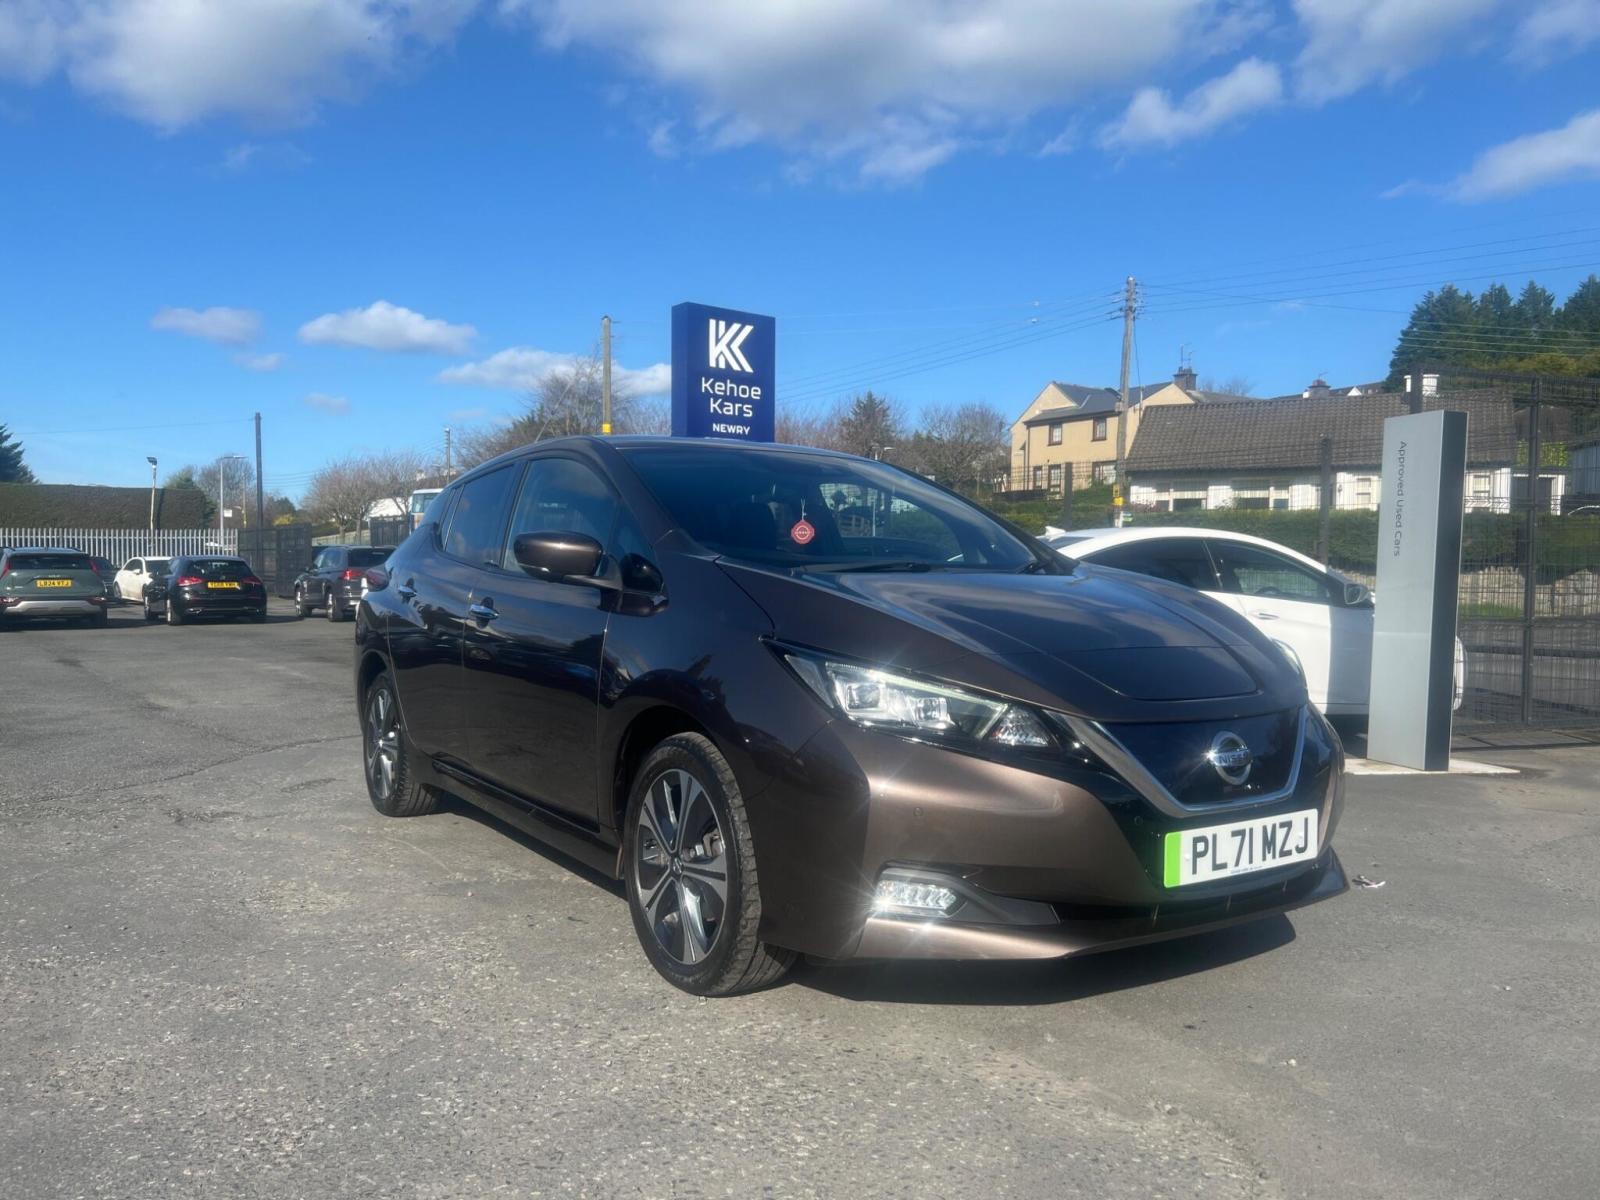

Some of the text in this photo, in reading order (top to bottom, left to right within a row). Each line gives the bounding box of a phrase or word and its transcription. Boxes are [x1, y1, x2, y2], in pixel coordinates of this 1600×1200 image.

[701, 377, 761, 400] Kehoe
[710, 397, 753, 418] Kars
[712, 423, 751, 435] NEWRY
[1394, 441, 1408, 557] Approved Used Cars
[1192, 817, 1308, 875] PL71 MZJ
